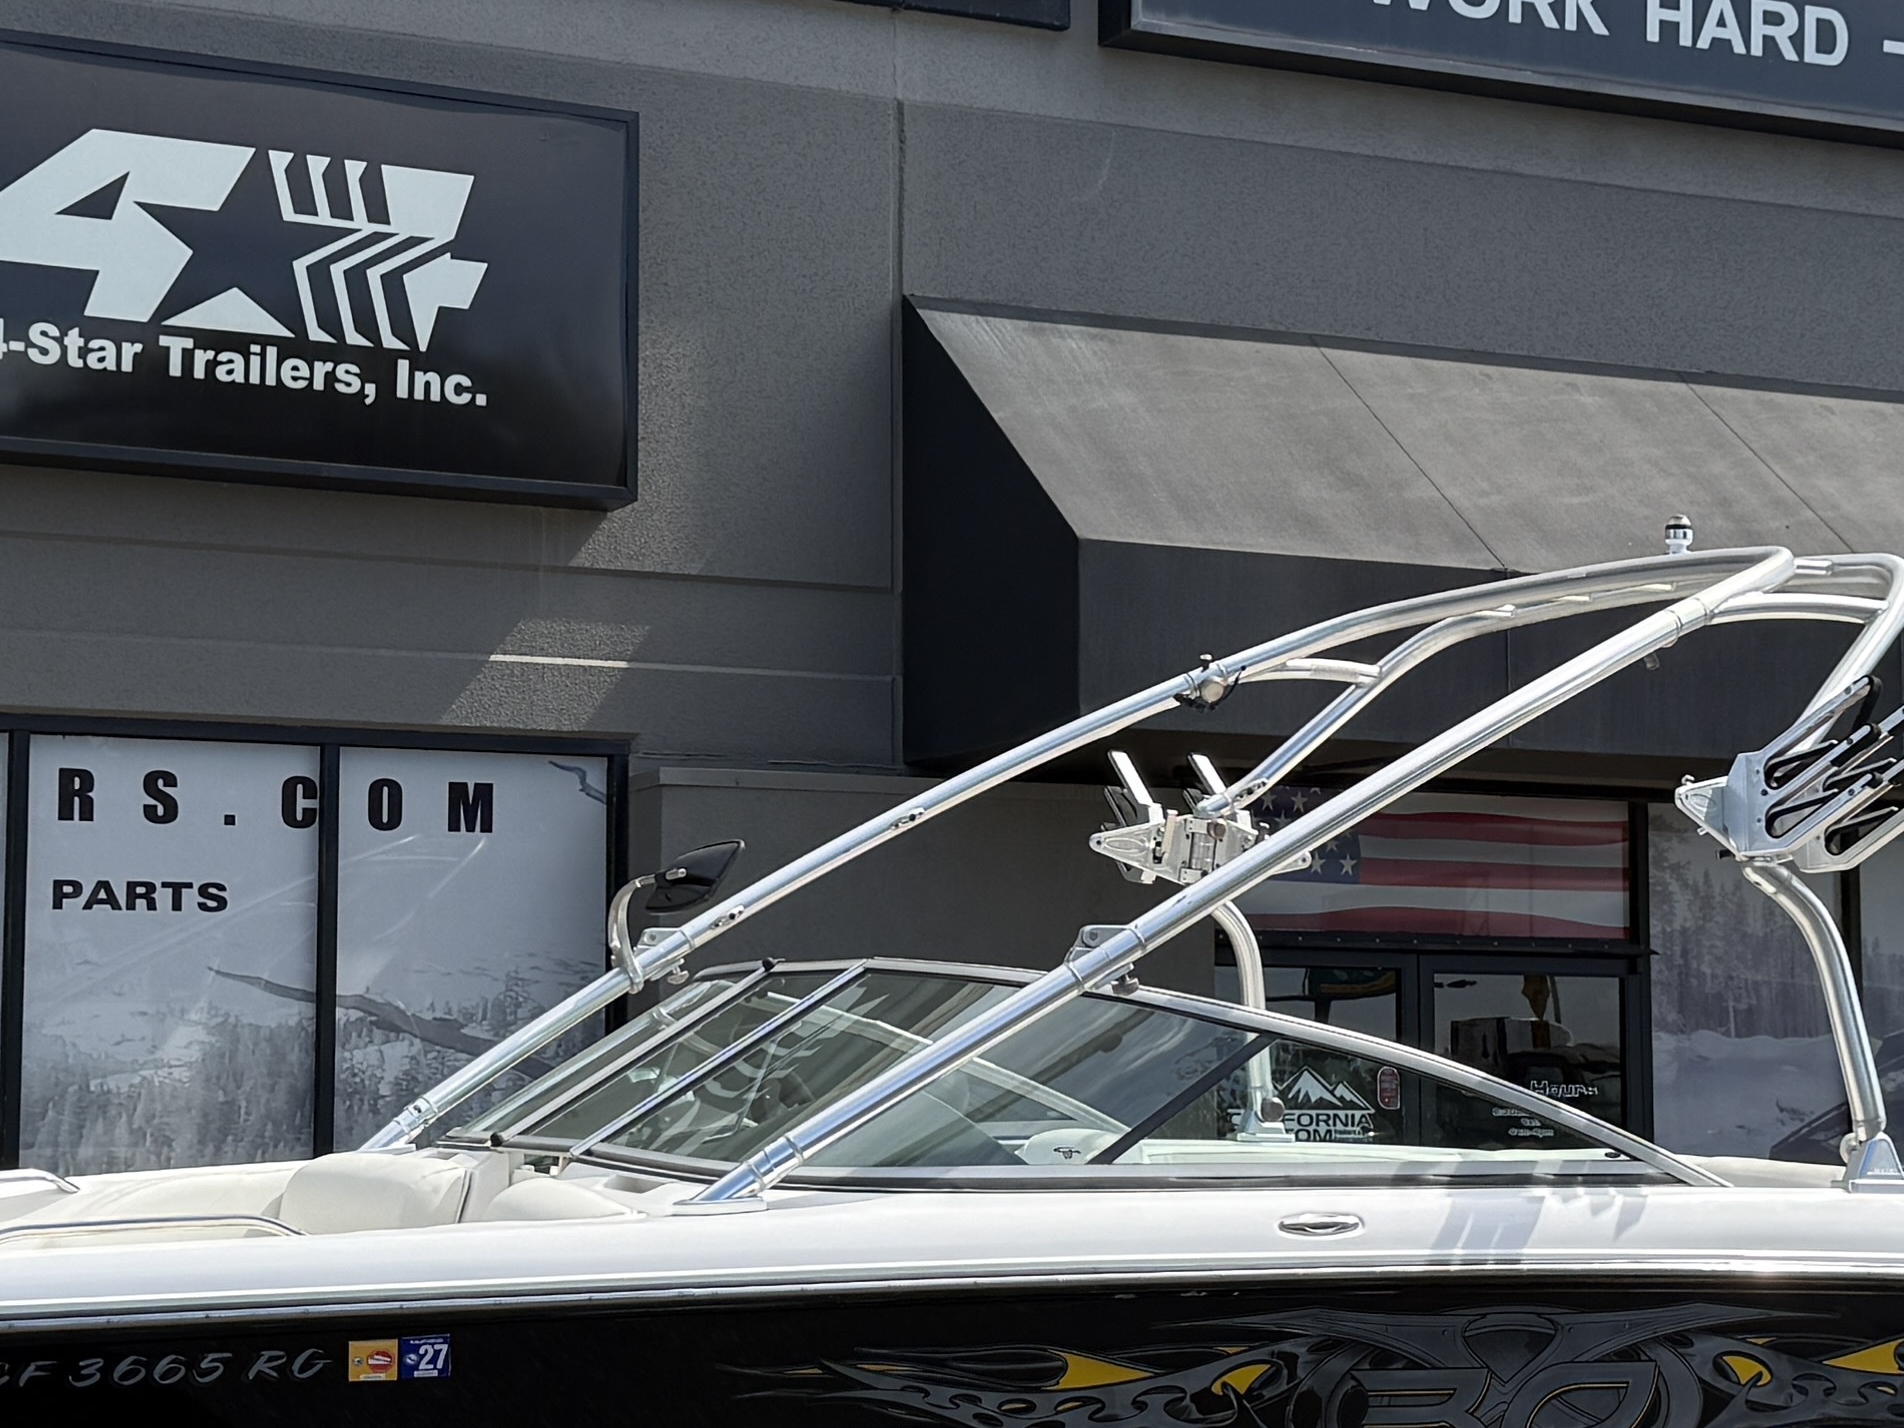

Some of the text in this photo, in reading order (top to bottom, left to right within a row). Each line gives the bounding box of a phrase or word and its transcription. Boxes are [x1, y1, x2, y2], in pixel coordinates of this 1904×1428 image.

[158, 335, 377, 405] Trailers,
[396, 358, 488, 406] Inc.
[52, 879, 228, 913] PARTS
[67, 1351, 233, 1388] 3665
[418, 1343, 449, 1370] 27
